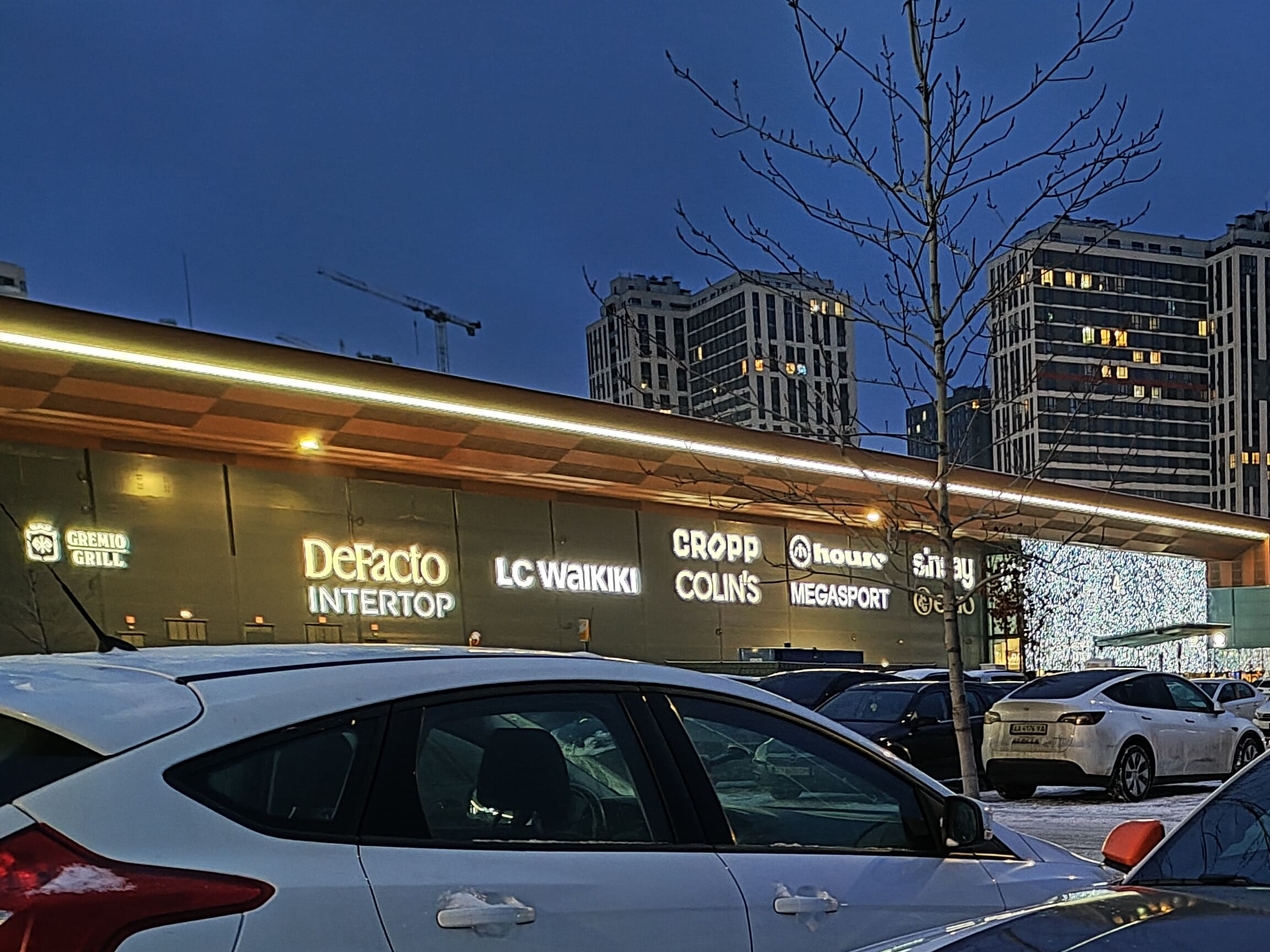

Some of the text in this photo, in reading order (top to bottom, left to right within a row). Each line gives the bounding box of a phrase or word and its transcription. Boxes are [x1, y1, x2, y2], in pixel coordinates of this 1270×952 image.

[66, 530, 128, 549] GREMIO
[673, 528, 762, 563] CROPP
[71, 551, 127, 567] GRILL
[303, 538, 449, 586] DeFacto
[813, 543, 888, 570] house
[495, 557, 535, 588] LC
[675, 569, 762, 604] COLIN'S
[308, 585, 455, 618] INTERTOP
[790, 582, 891, 609] MEGASPORT
